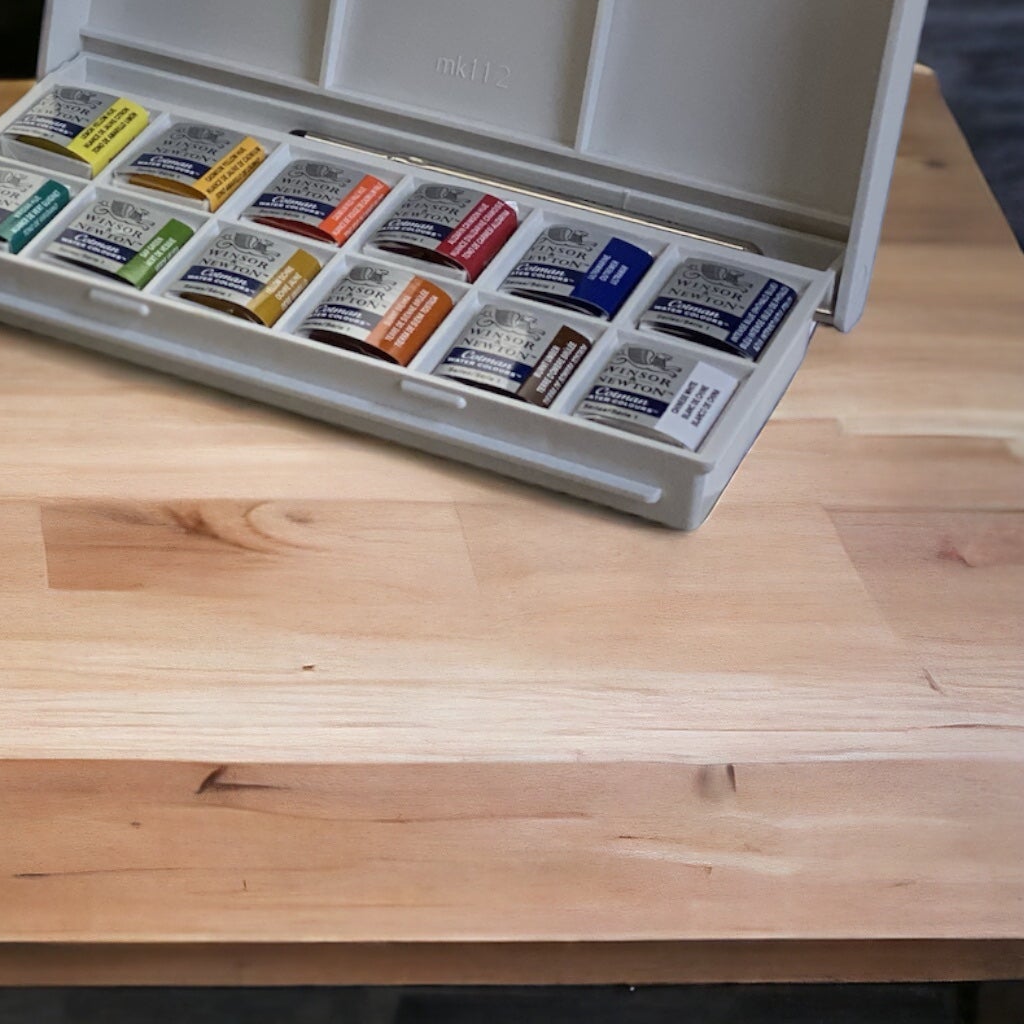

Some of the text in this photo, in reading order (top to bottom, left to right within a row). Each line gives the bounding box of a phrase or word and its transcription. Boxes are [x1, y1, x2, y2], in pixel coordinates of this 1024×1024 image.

[150, 156, 194, 170] Cotman
[281, 177, 340, 195] WINSOR
[271, 195, 318, 210] Cotman
[78, 221, 134, 247] NEWTON
[85, 213, 143, 239] WINSOR
[387, 218, 435, 231] Cotman
[74, 233, 121, 254] Cotman
[198, 257, 261, 278] NEWTON
[209, 248, 269, 270] WINSOR
[186, 274, 214, 283] WATER
[200, 267, 249, 286] Cotman
[516, 262, 566, 276] Cotman
[677, 278, 743, 302] WINSOR
[653, 305, 683, 315] WATER
[667, 300, 721, 318] Cotman
[470, 327, 535, 351] WINSOR
[447, 357, 477, 366] WATER
[460, 349, 513, 370] Cotman
[595, 386, 649, 407] Cotman
